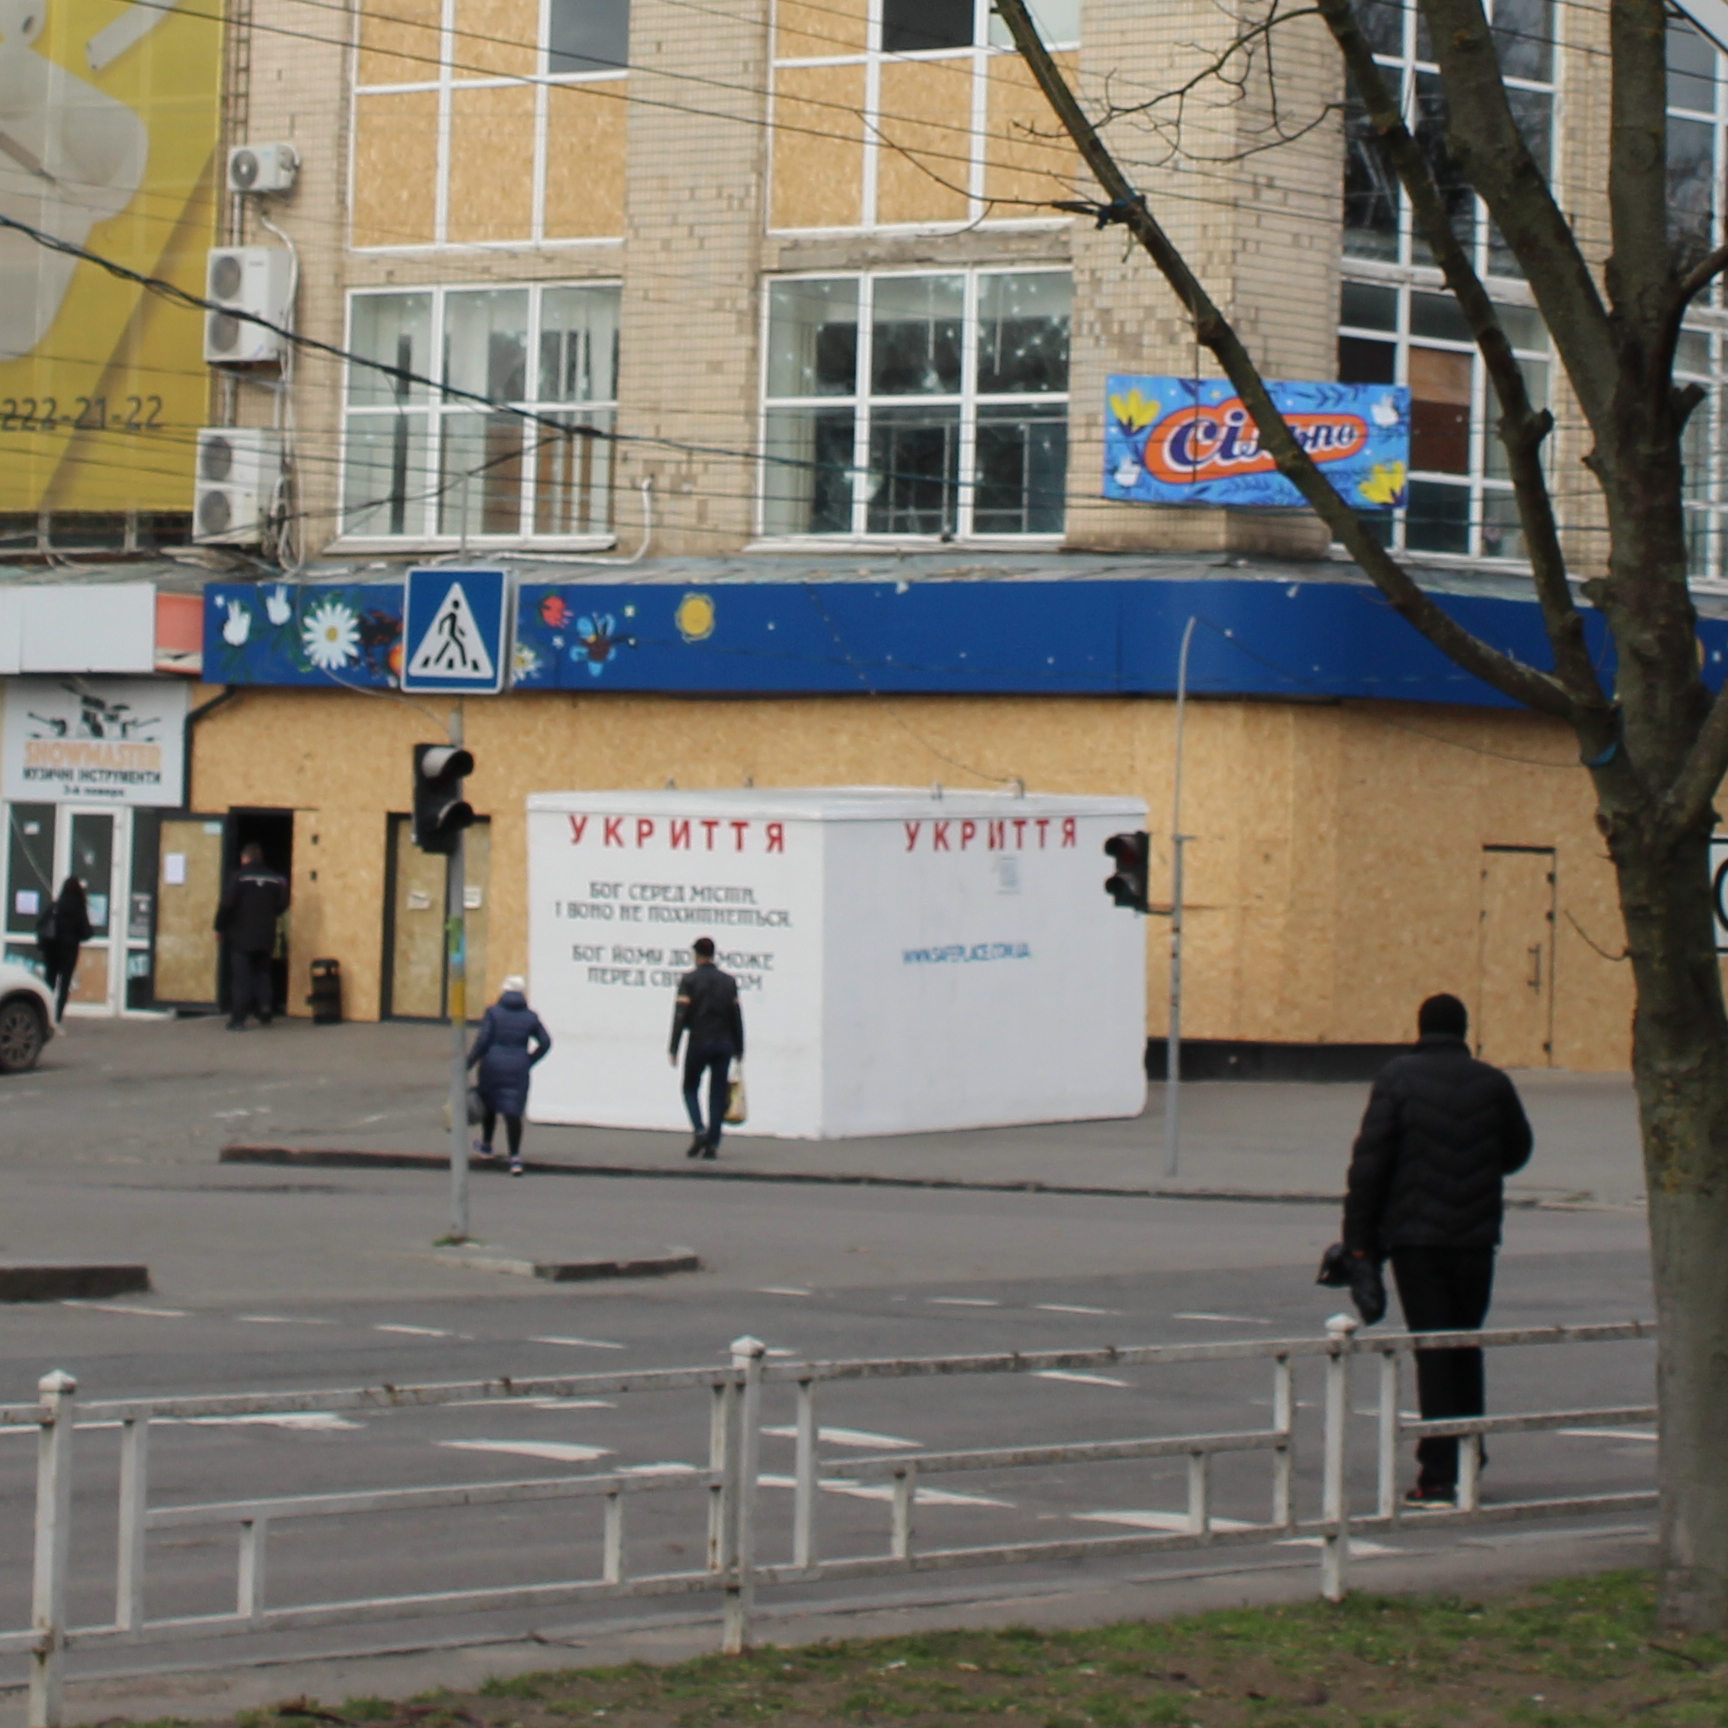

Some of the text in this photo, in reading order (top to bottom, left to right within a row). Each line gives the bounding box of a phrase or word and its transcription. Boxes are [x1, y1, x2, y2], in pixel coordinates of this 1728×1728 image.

[569, 815, 786, 854] УКРИТТЯ
[904, 816, 1078, 852] УКРИТТЯ
[589, 881, 623, 900] БОГ
[572, 944, 605, 962] БОГ
